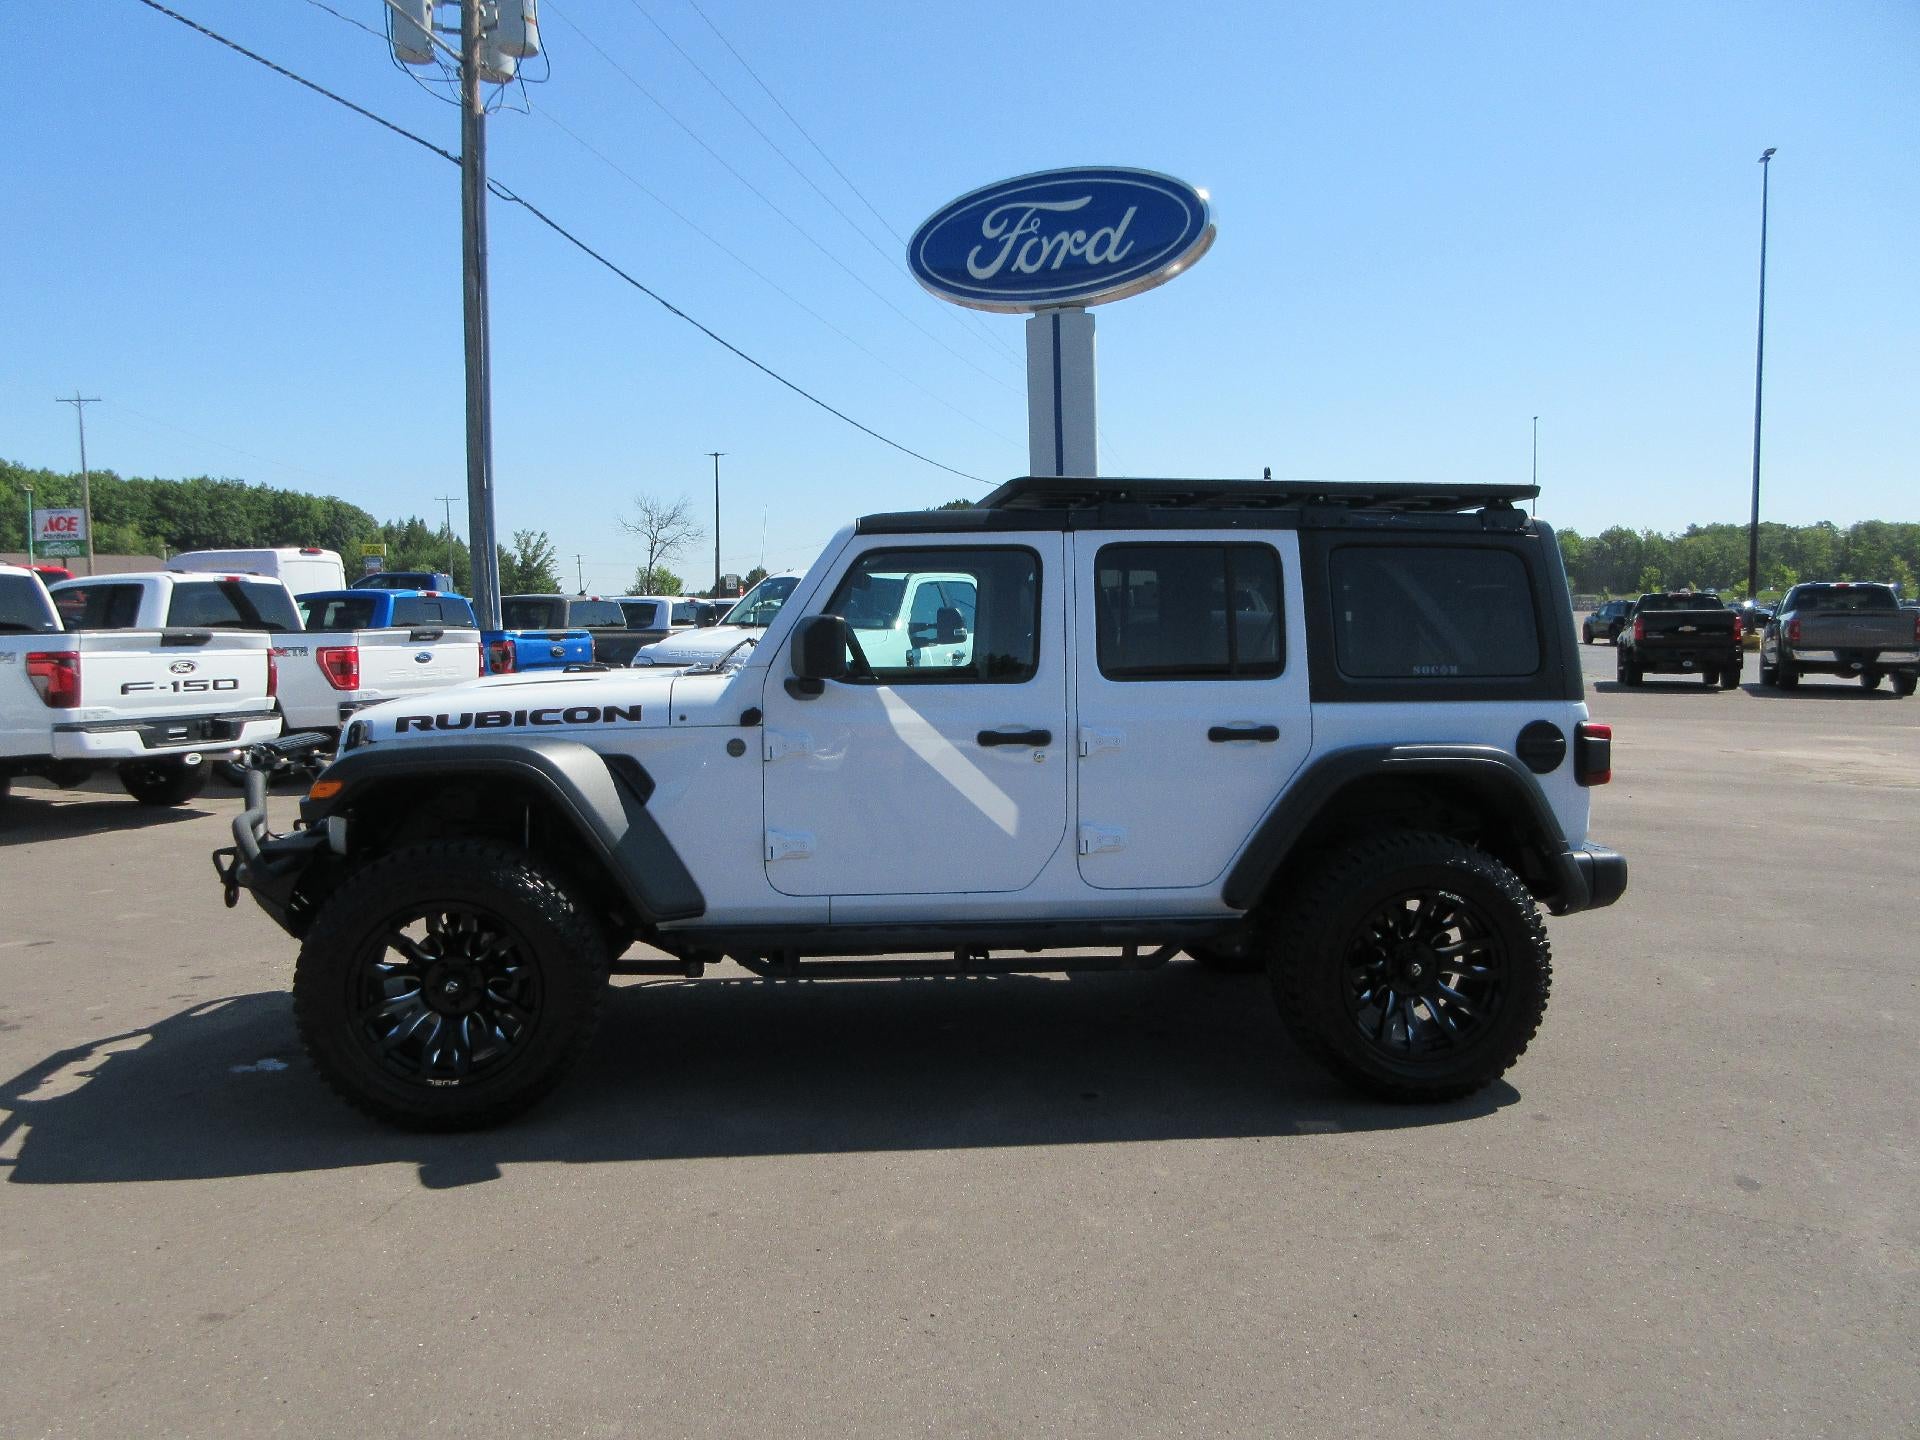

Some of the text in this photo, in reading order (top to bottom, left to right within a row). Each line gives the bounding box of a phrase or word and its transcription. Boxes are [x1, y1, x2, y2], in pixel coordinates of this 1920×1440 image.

[966, 195, 1138, 280] Ford
[43, 516, 79, 532] ACE
[120, 678, 240, 696] F-150
[395, 704, 643, 734] RUBICON
